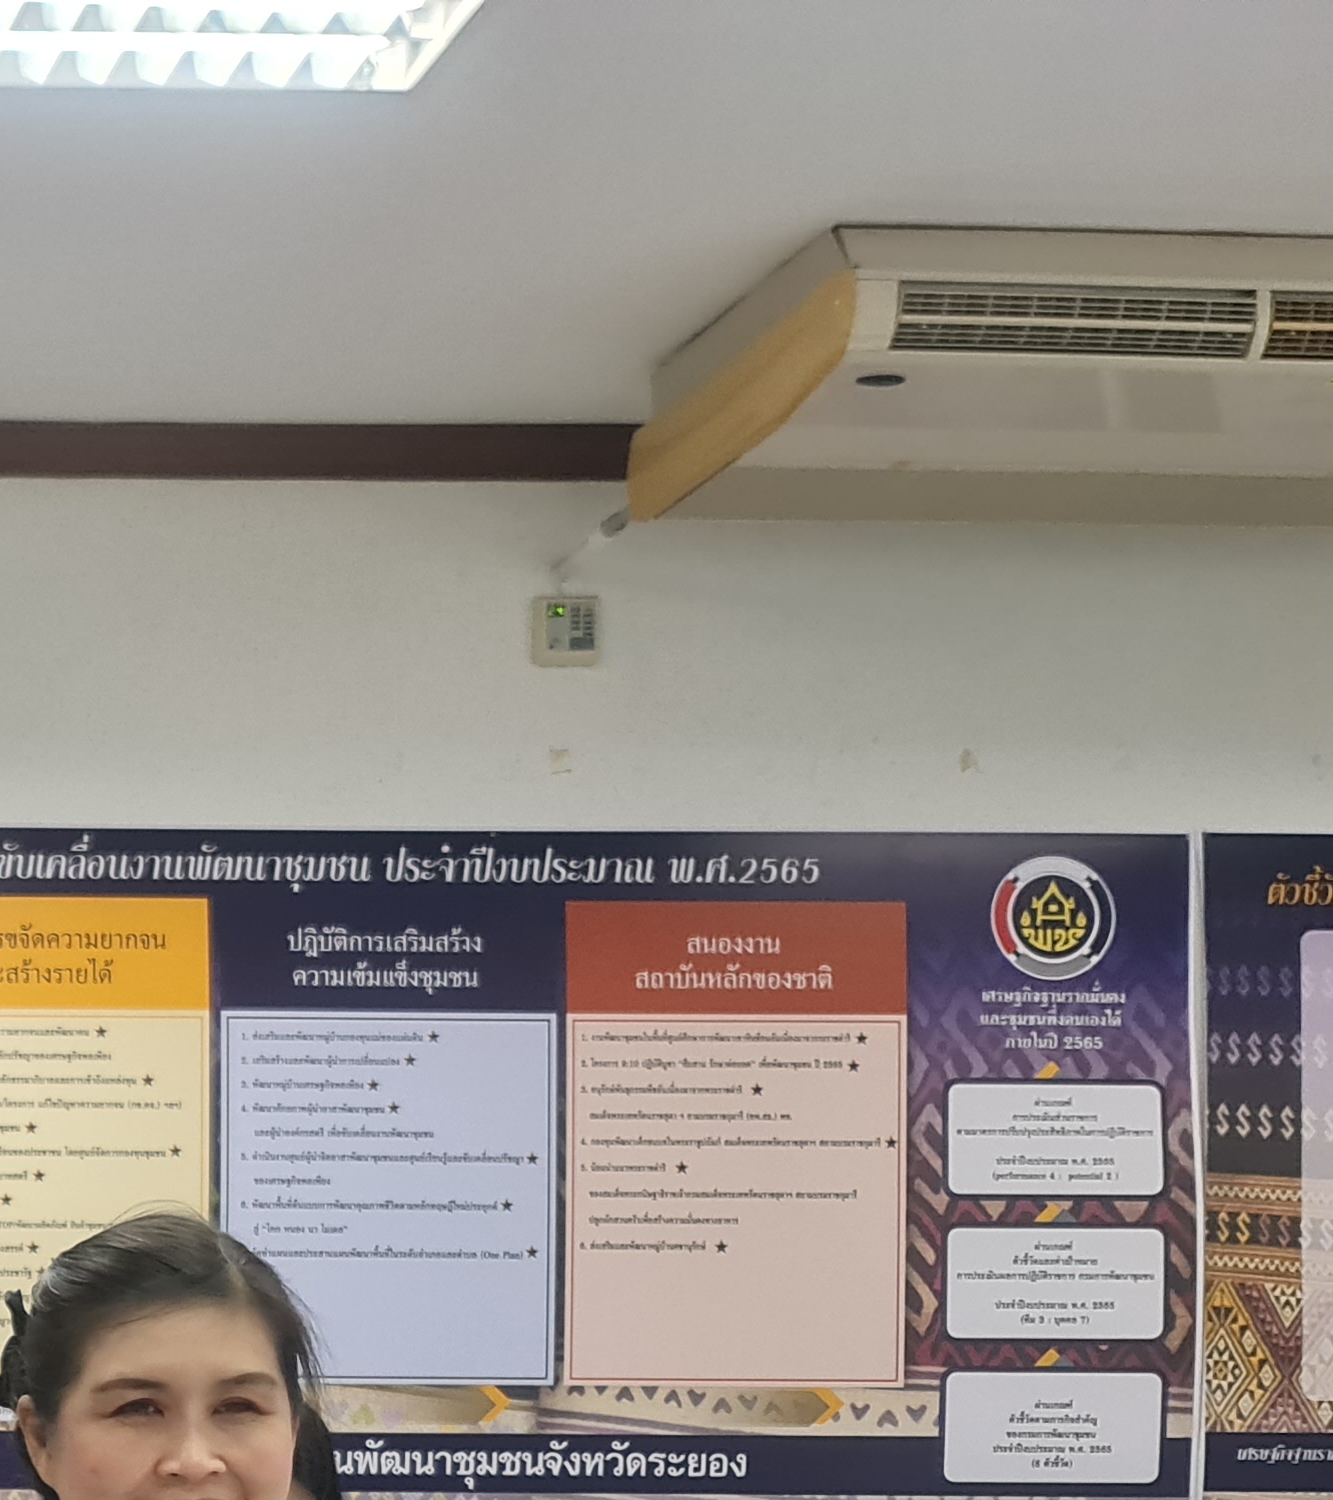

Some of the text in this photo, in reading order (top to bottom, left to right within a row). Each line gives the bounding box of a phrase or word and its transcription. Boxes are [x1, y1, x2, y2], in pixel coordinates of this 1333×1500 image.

[383, 843, 655, 886] ประจำปีงบประมาณ
[668, 852, 822, 886] พ.ศ.2565
[286, 926, 483, 959] ปฏิบัติการเสริมสร้าง
[686, 934, 781, 956] สนองงาน
[292, 959, 479, 996] ความเข้มแข็งชุมชน
[634, 965, 835, 991] สถาบันหลักของชาติ
[1004, 1030, 1104, 1051] ภายในปี 2565
[1068, 1170, 1104, 1182] potential
